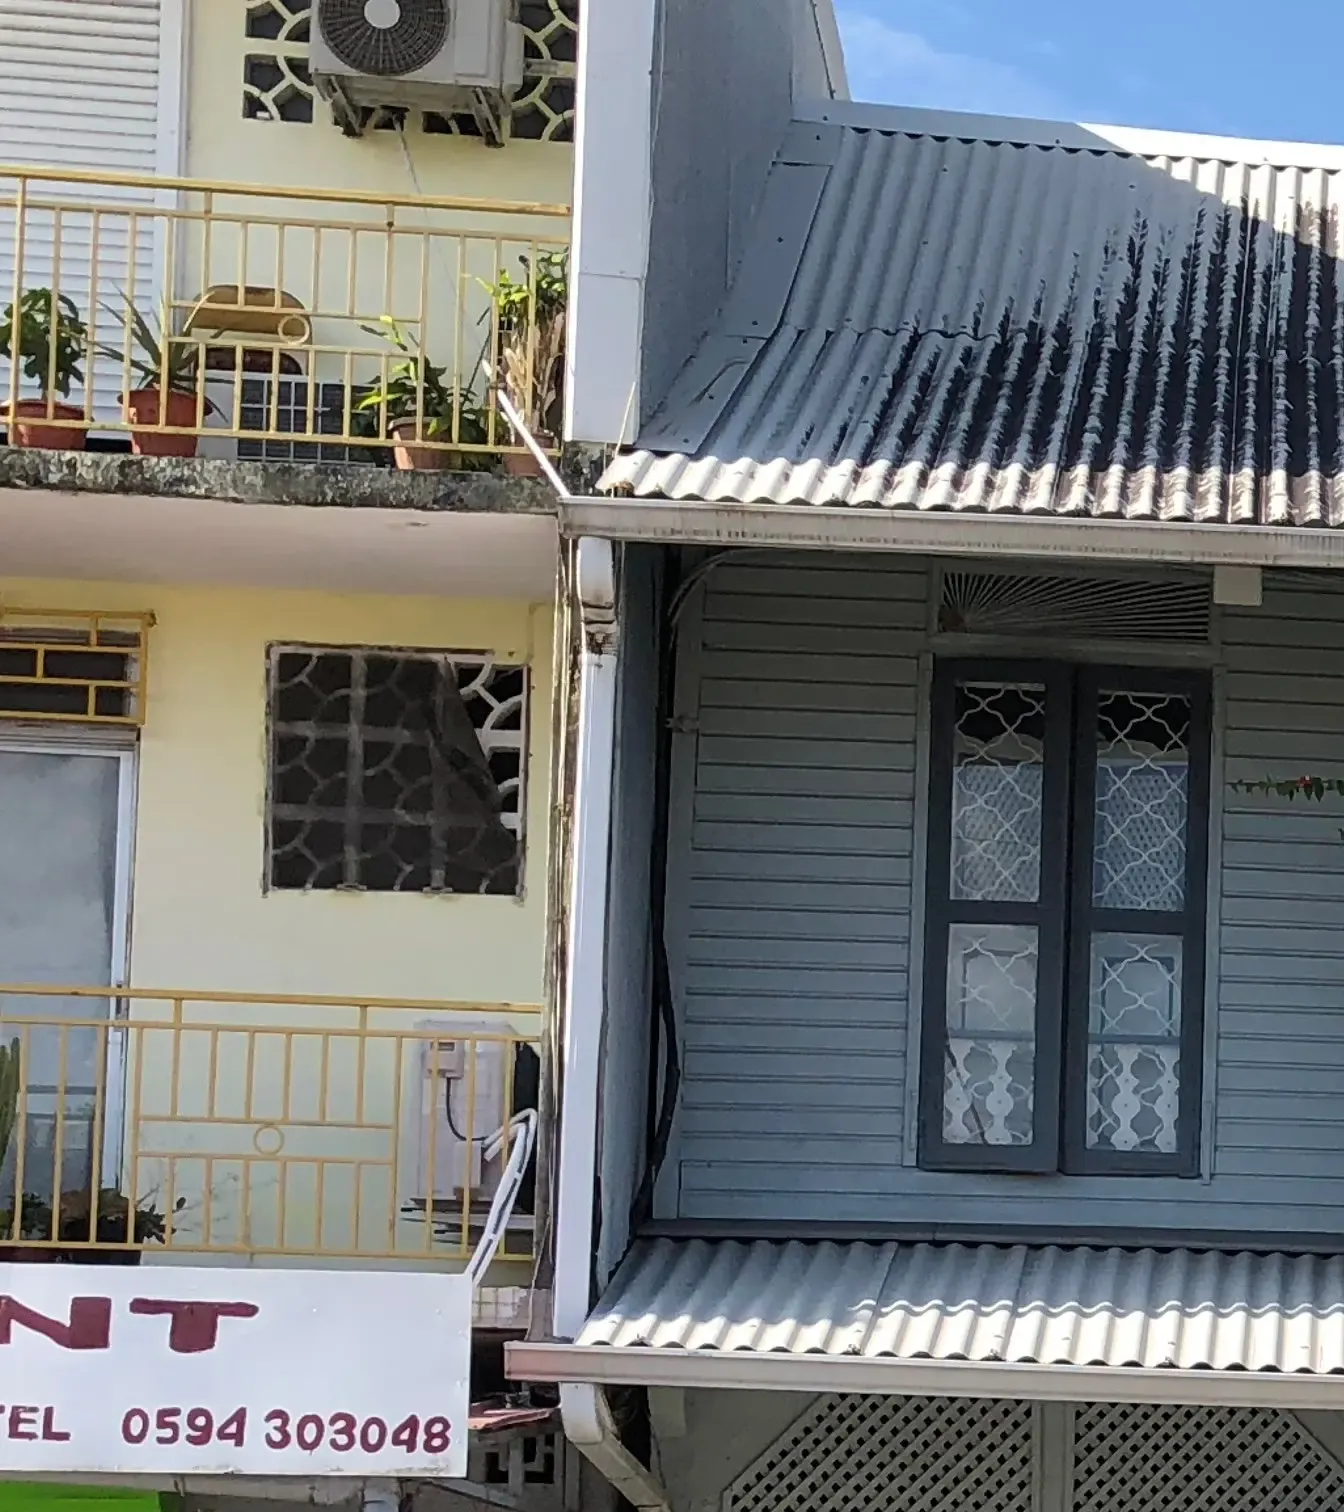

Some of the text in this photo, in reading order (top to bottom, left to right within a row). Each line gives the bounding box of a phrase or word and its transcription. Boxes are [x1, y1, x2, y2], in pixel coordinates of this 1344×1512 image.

[0, 1295, 259, 1353] NT
[0, 1404, 452, 1454] EL 0594 303048
